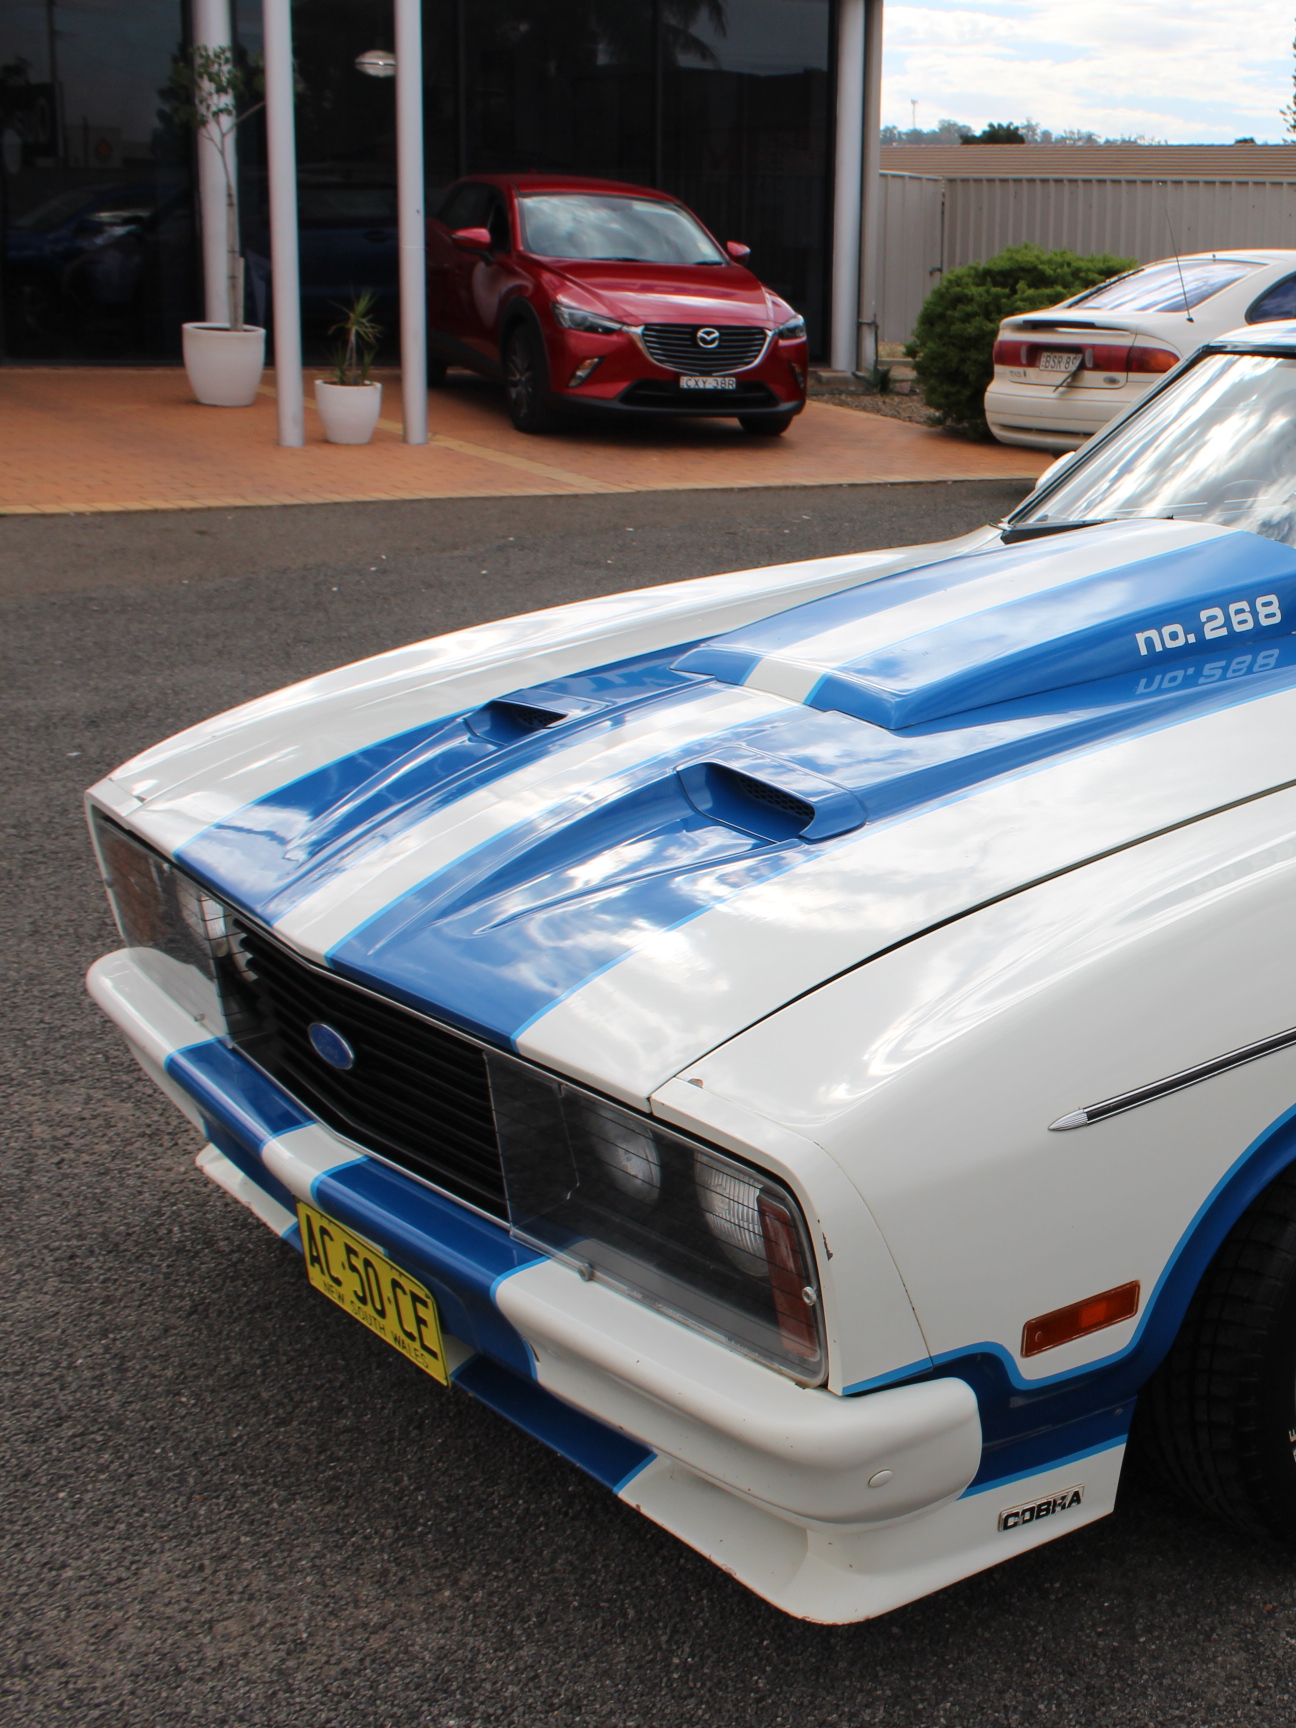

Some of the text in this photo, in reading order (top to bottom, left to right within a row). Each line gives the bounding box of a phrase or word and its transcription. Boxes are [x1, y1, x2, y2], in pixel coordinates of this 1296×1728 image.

[1135, 594, 1282, 656] no. 268
[322, 1280, 429, 1369] NEW SOUTH WALES
[1002, 1488, 1082, 1531] COBRA
